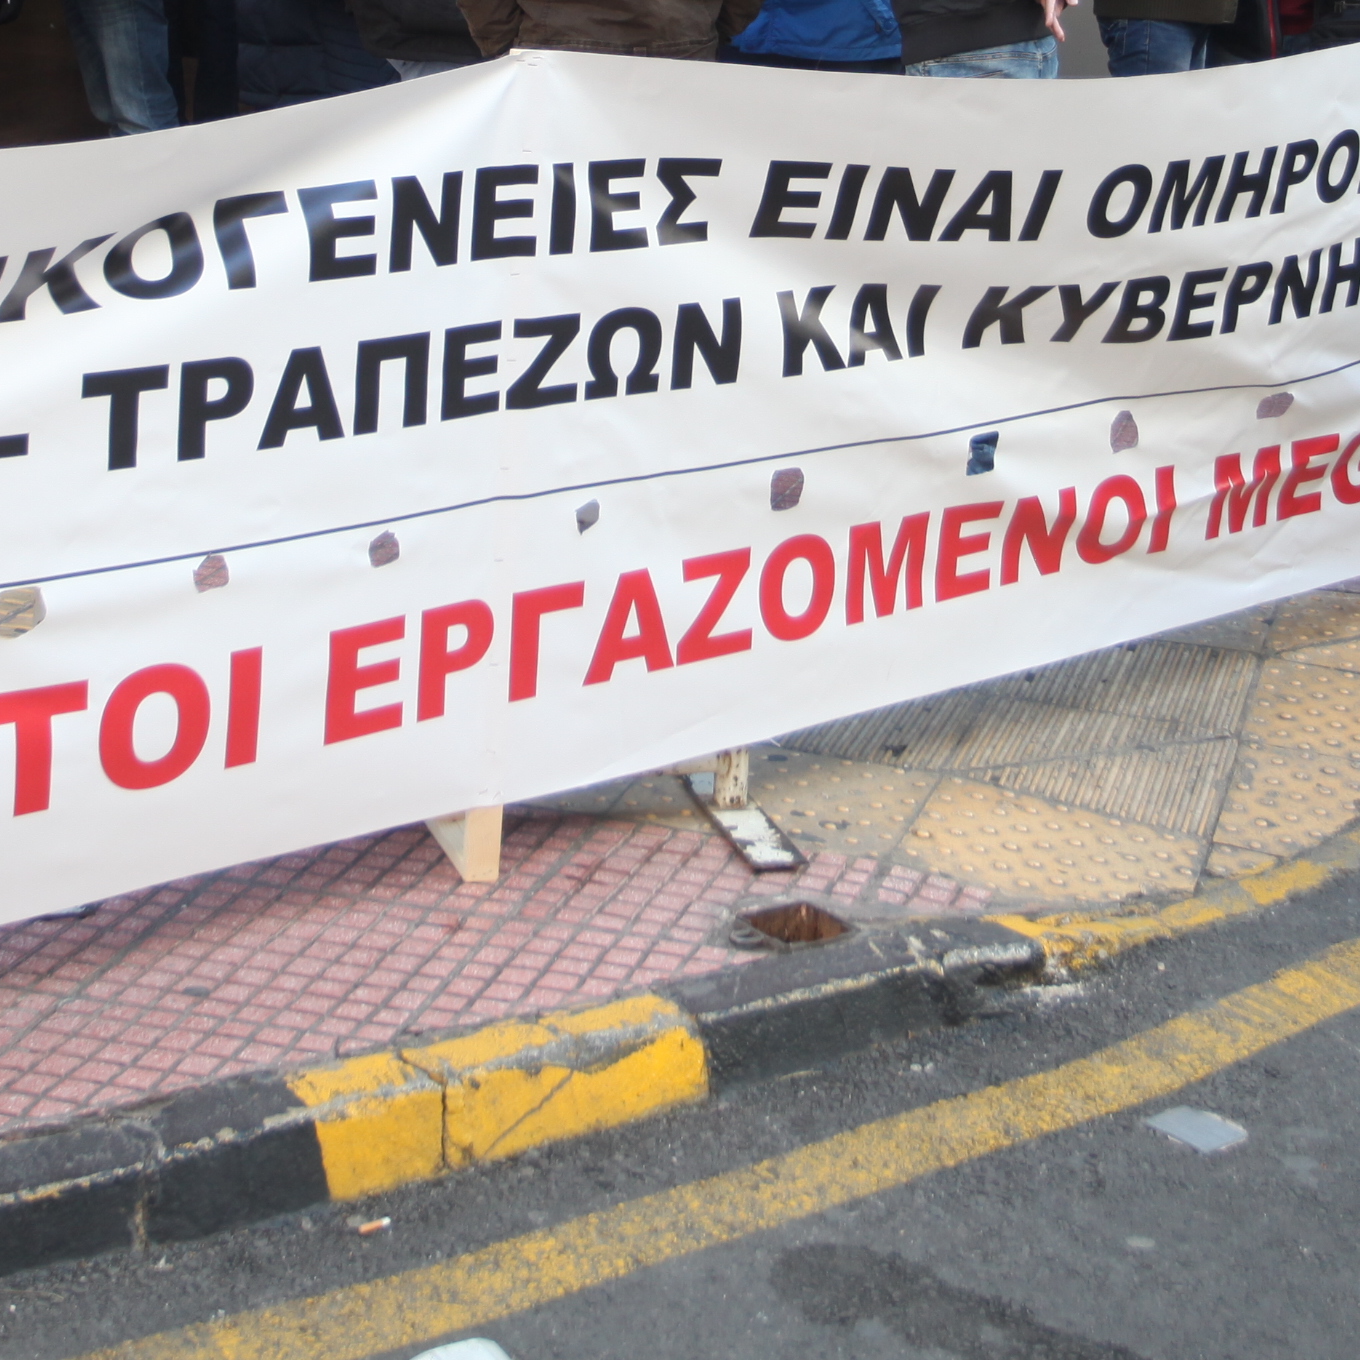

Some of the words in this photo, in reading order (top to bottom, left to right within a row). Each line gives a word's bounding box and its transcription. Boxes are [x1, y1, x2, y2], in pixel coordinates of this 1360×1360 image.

[749, 160, 1063, 242] ΕΙΝΑΙ
[81, 298, 743, 471] ΤΡΑΠΕΖΩΝ
[780, 283, 942, 378] ΚΑΙ
[324, 466, 1178, 745] ΕΡΓΑΖΟΜΕΝΟΙ
